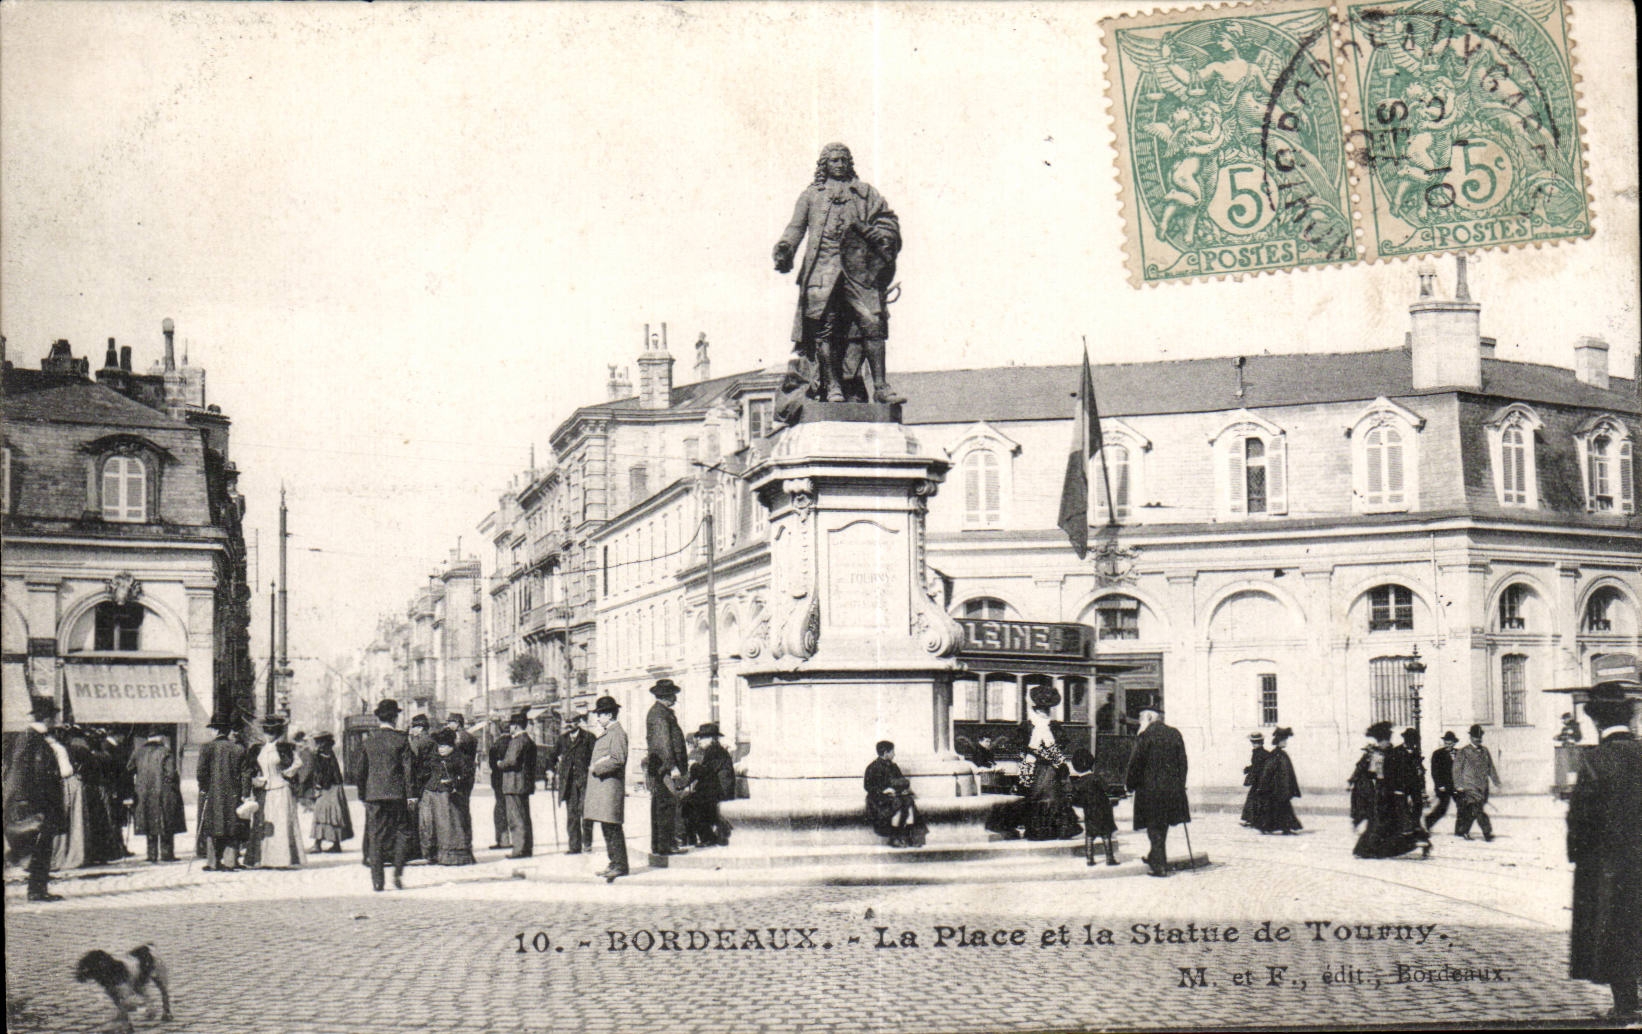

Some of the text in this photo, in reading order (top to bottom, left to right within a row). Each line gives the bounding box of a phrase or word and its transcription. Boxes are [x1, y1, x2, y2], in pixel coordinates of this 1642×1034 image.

[1435, 217, 1528, 247] POSTES
[1201, 242, 1295, 272] POSTES
[74, 682, 181, 700] MERCERIE
